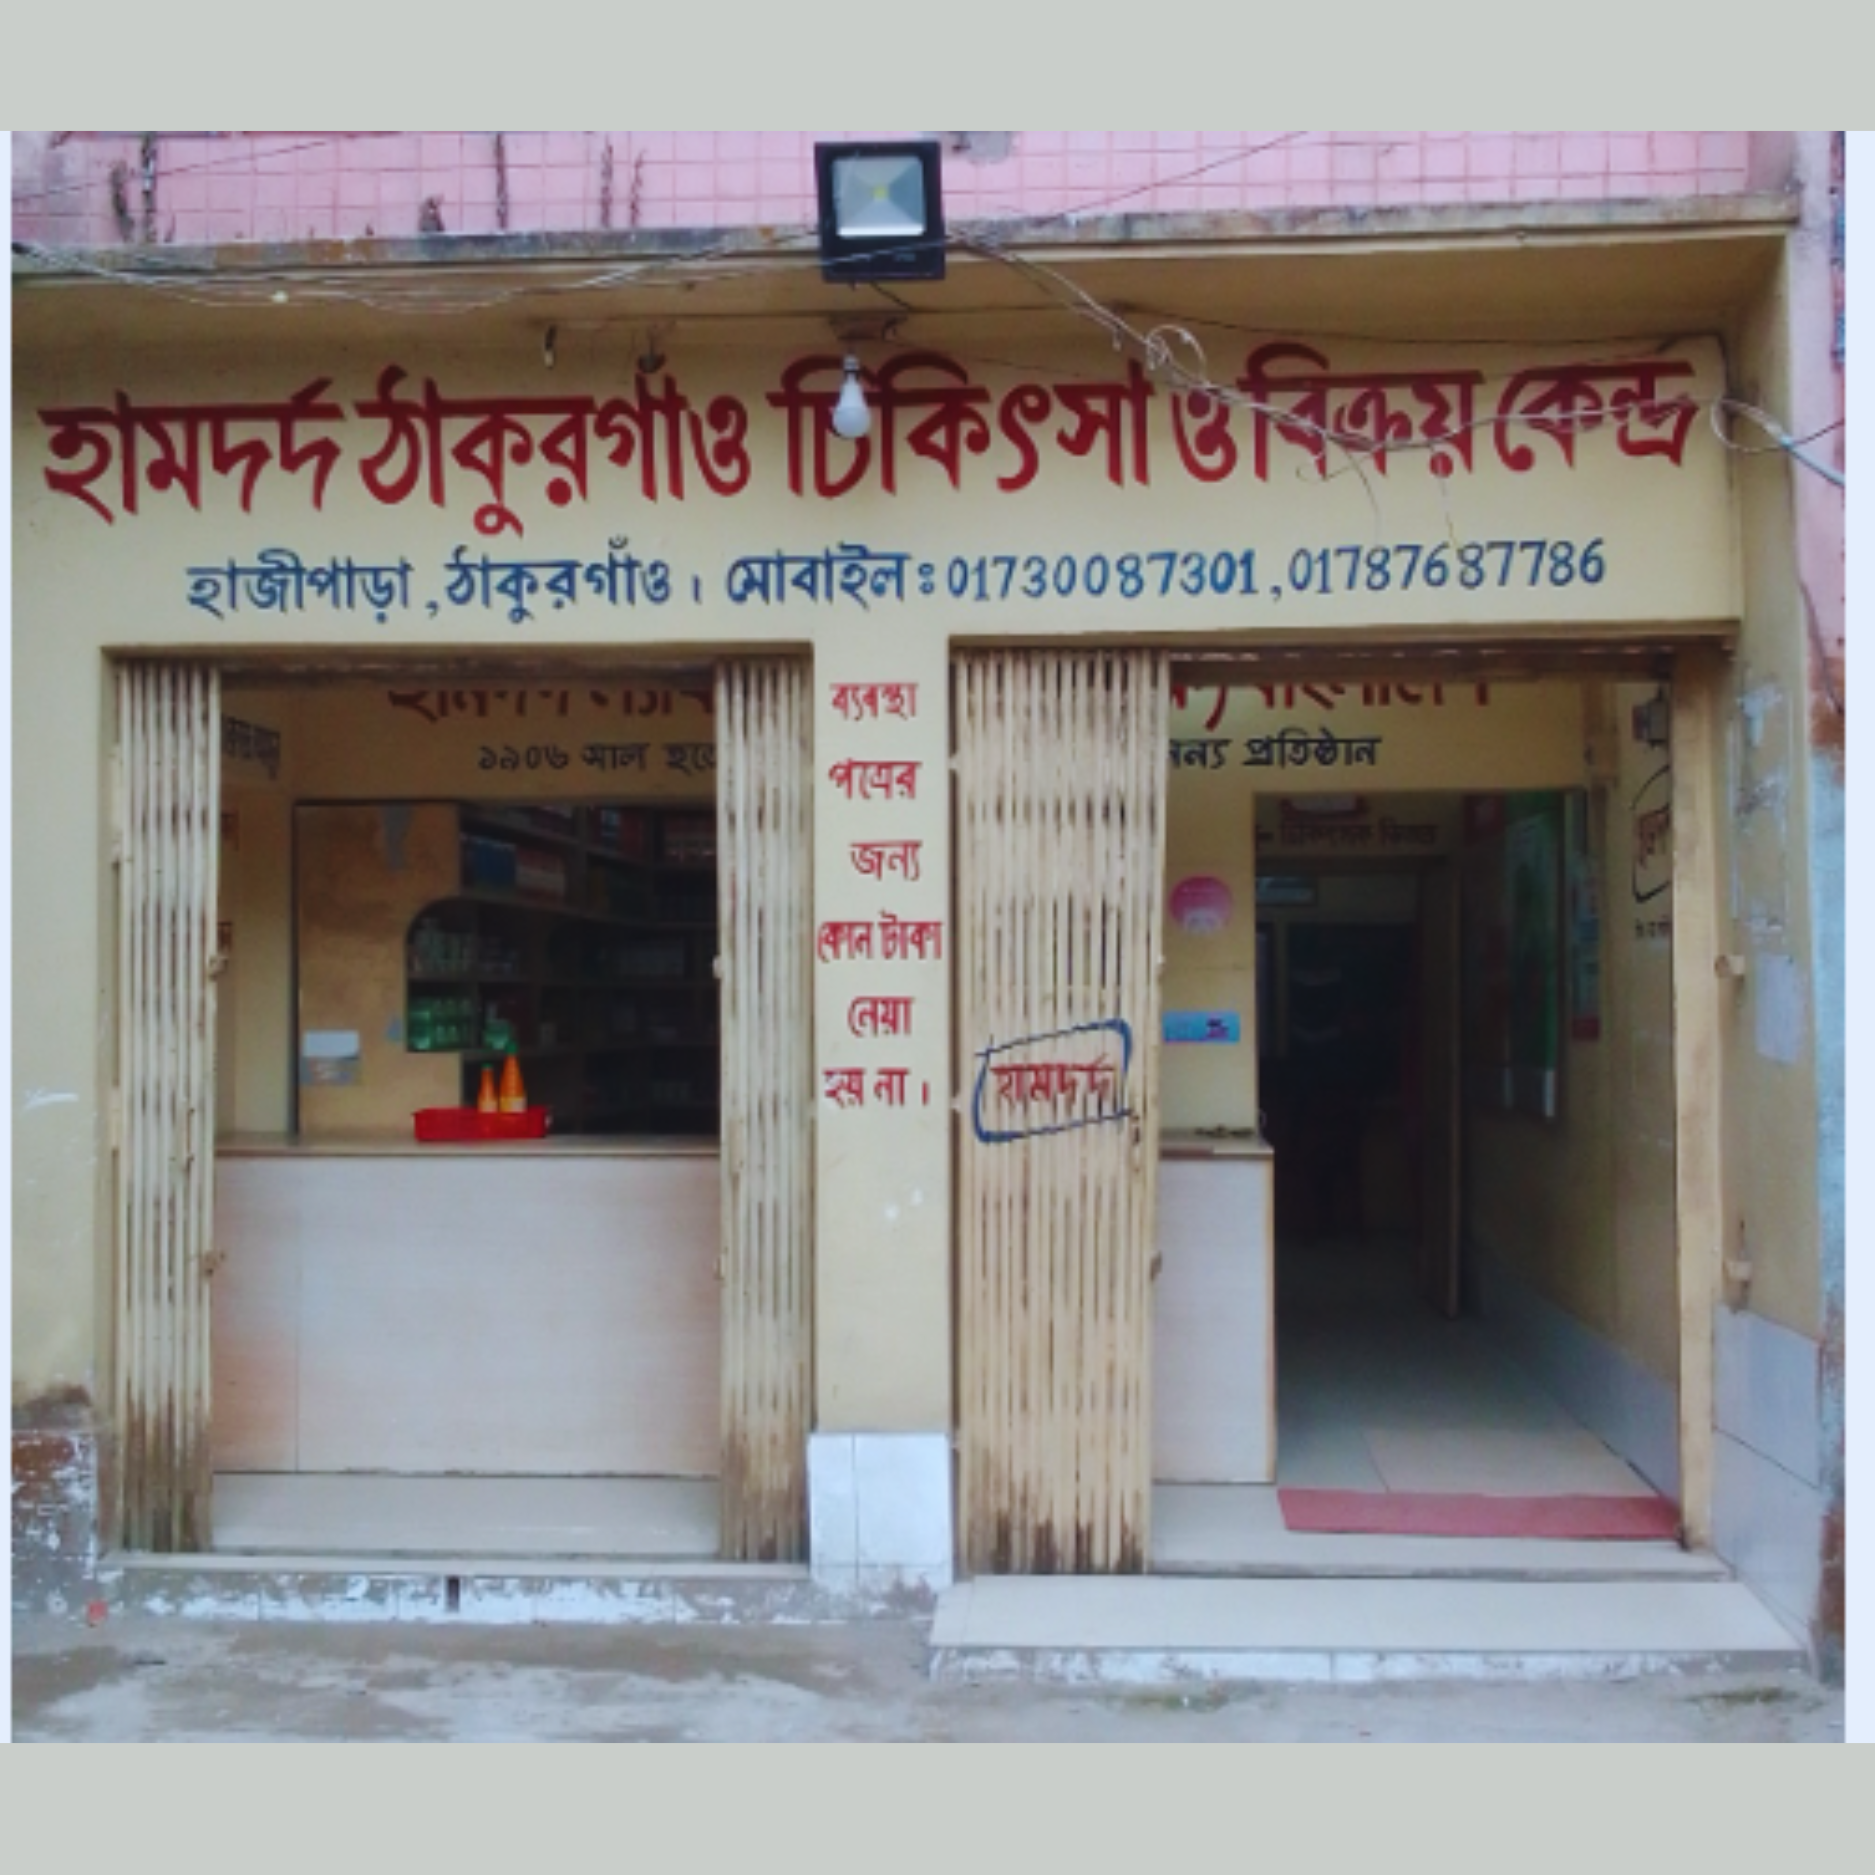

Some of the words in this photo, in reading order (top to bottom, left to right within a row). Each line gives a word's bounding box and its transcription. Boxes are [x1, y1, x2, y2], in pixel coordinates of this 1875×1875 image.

[38, 389, 347, 526] হামদর্দ
[766, 350, 1157, 500] চিকিৎসা
[1171, 388, 1238, 483] ও
[1236, 341, 1486, 482] বিক্রয়
[1493, 360, 1700, 474] কেন্দ্র
[1288, 537, 1608, 597] 01787687786
[478, 744, 569, 772] ১৯০৬
[828, 758, 922, 799] পত্রের
[850, 840, 923, 880] জন্য
[877, 911, 943, 960] টাকা
[847, 995, 914, 1036] নেয়া
[989, 1055, 1116, 1107] হামদর্দ
